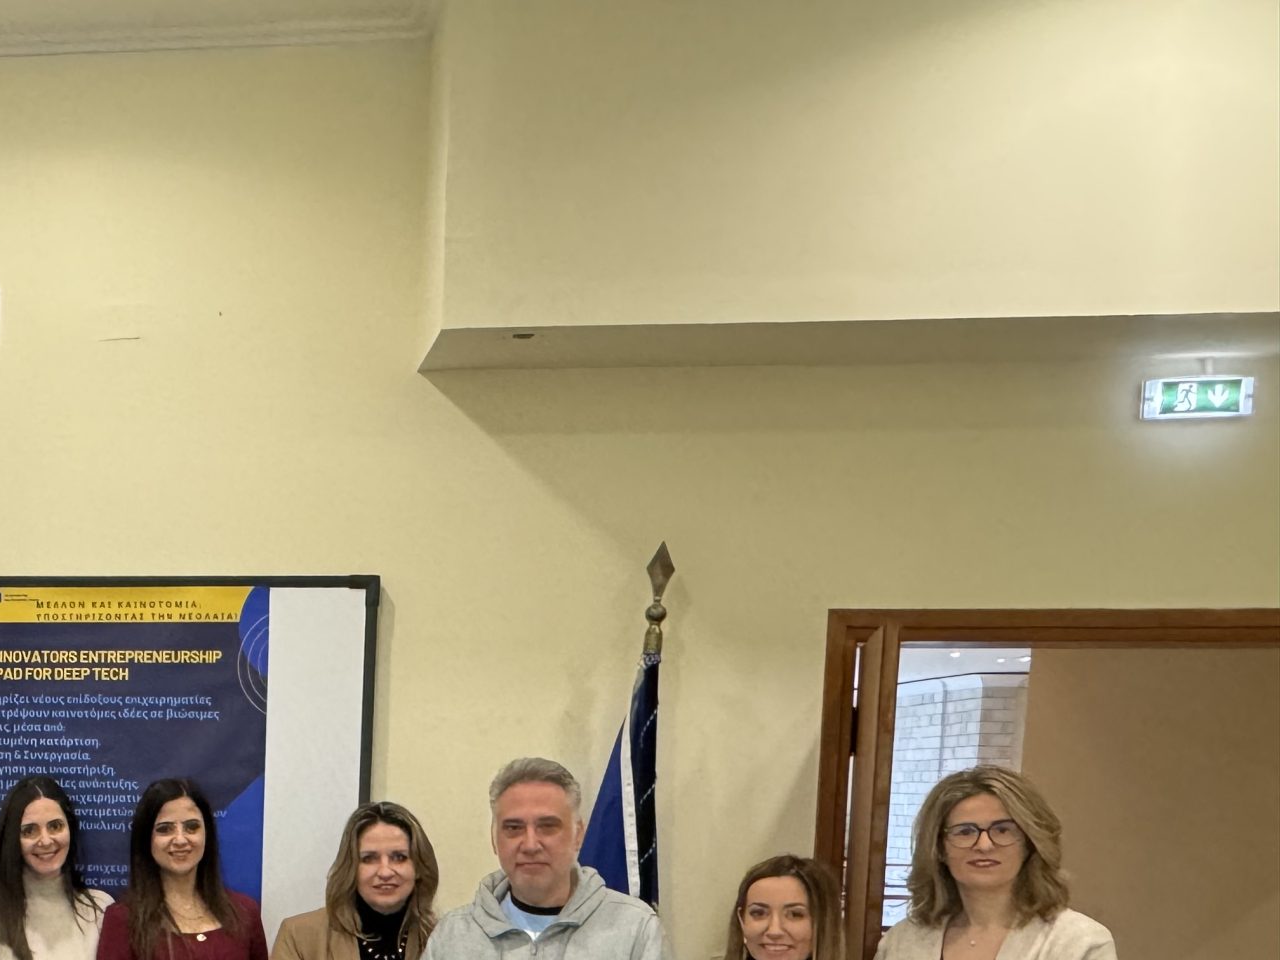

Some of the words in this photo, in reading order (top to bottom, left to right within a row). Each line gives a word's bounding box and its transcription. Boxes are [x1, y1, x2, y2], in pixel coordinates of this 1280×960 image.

[91, 601, 112, 609] ΚΑΙ
[151, 613, 173, 621] ΤΗΝ
[80, 650, 222, 663] ENTREPRENEURSHIP
[25, 667, 52, 681] FOR
[54, 667, 91, 681] DEEP
[92, 667, 129, 681] TECH
[32, 694, 65, 705] νέους
[67, 694, 123, 705] επίδοξους
[125, 695, 212, 706] επιχειρηματίες
[52, 708, 116, 720] καινοτόμες
[118, 708, 148, 719] ιδέες
[150, 710, 163, 718] σε
[166, 708, 220, 720] βιώσιμες
[13, 722, 41, 733] μέσα
[14, 750, 21, 759] &
